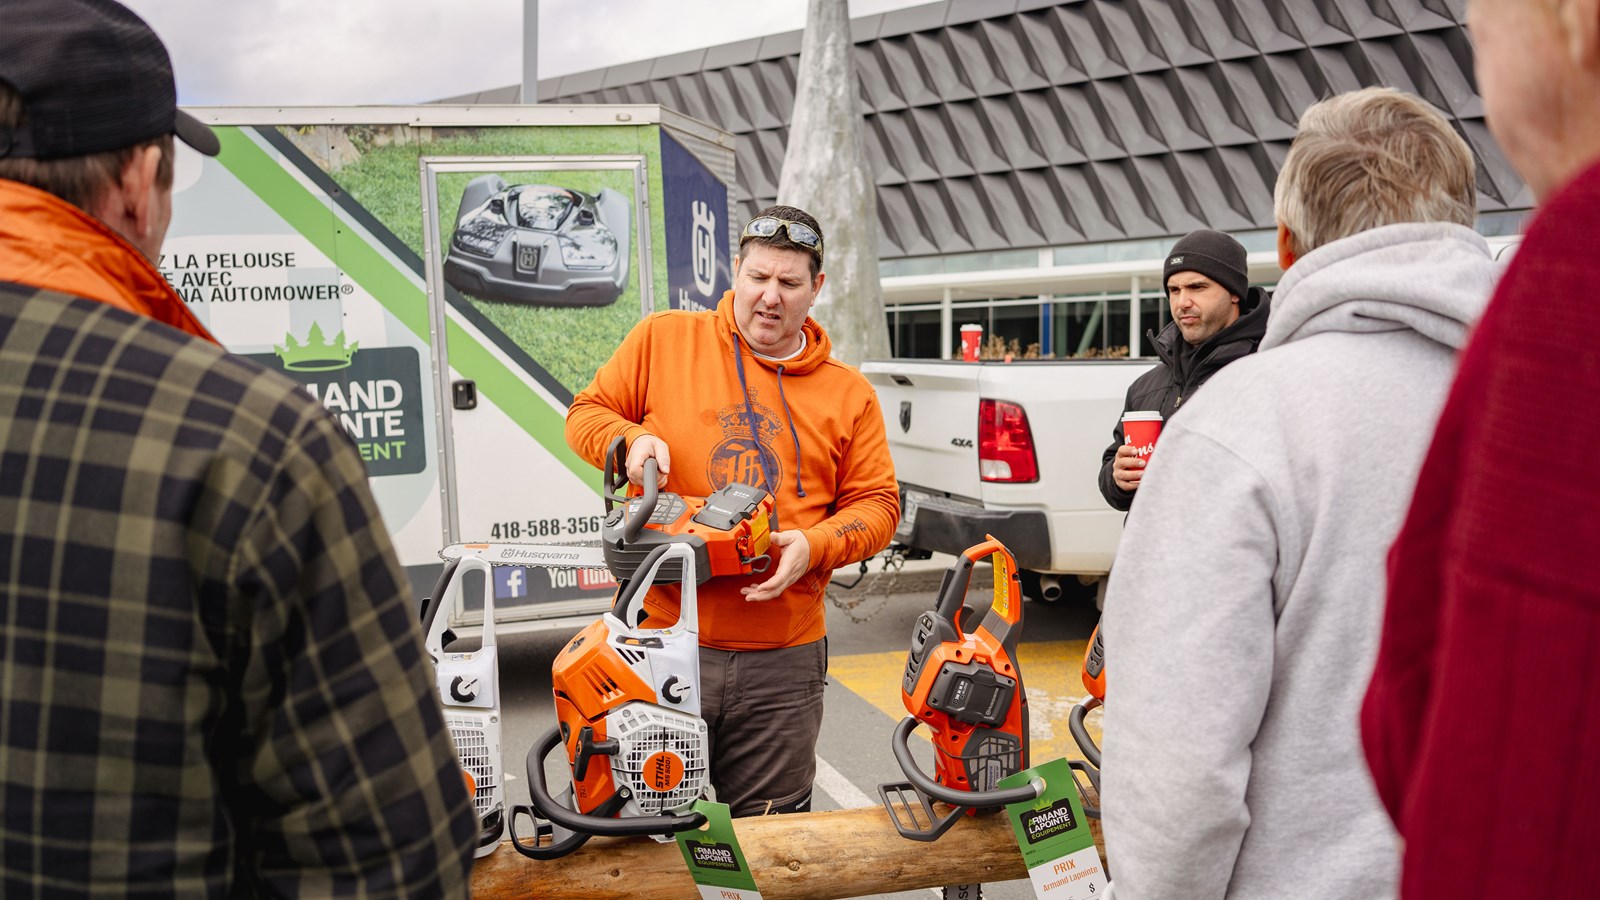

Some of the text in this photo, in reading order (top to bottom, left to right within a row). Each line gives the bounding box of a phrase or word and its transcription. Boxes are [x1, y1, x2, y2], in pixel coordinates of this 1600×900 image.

[174, 254, 199, 269] LA
[206, 252, 296, 269] PELOUSE
[181, 271, 233, 287] AVEC
[515, 550, 580, 560] Husqvarna
[655, 755, 665, 789] STIHL
[664, 774, 671, 787] MS
[1028, 806, 1068, 828] ARMAND
[1029, 813, 1071, 834] LAPOINTE
[693, 846, 731, 858] ARMAND
[694, 853, 734, 864] LAPOINTE
[1053, 858, 1076, 875] PRIX
[1043, 866, 1099, 892] Armand Lapointe
[720, 890, 743, 900] PRIX
[1088, 882, 1096, 893] $
